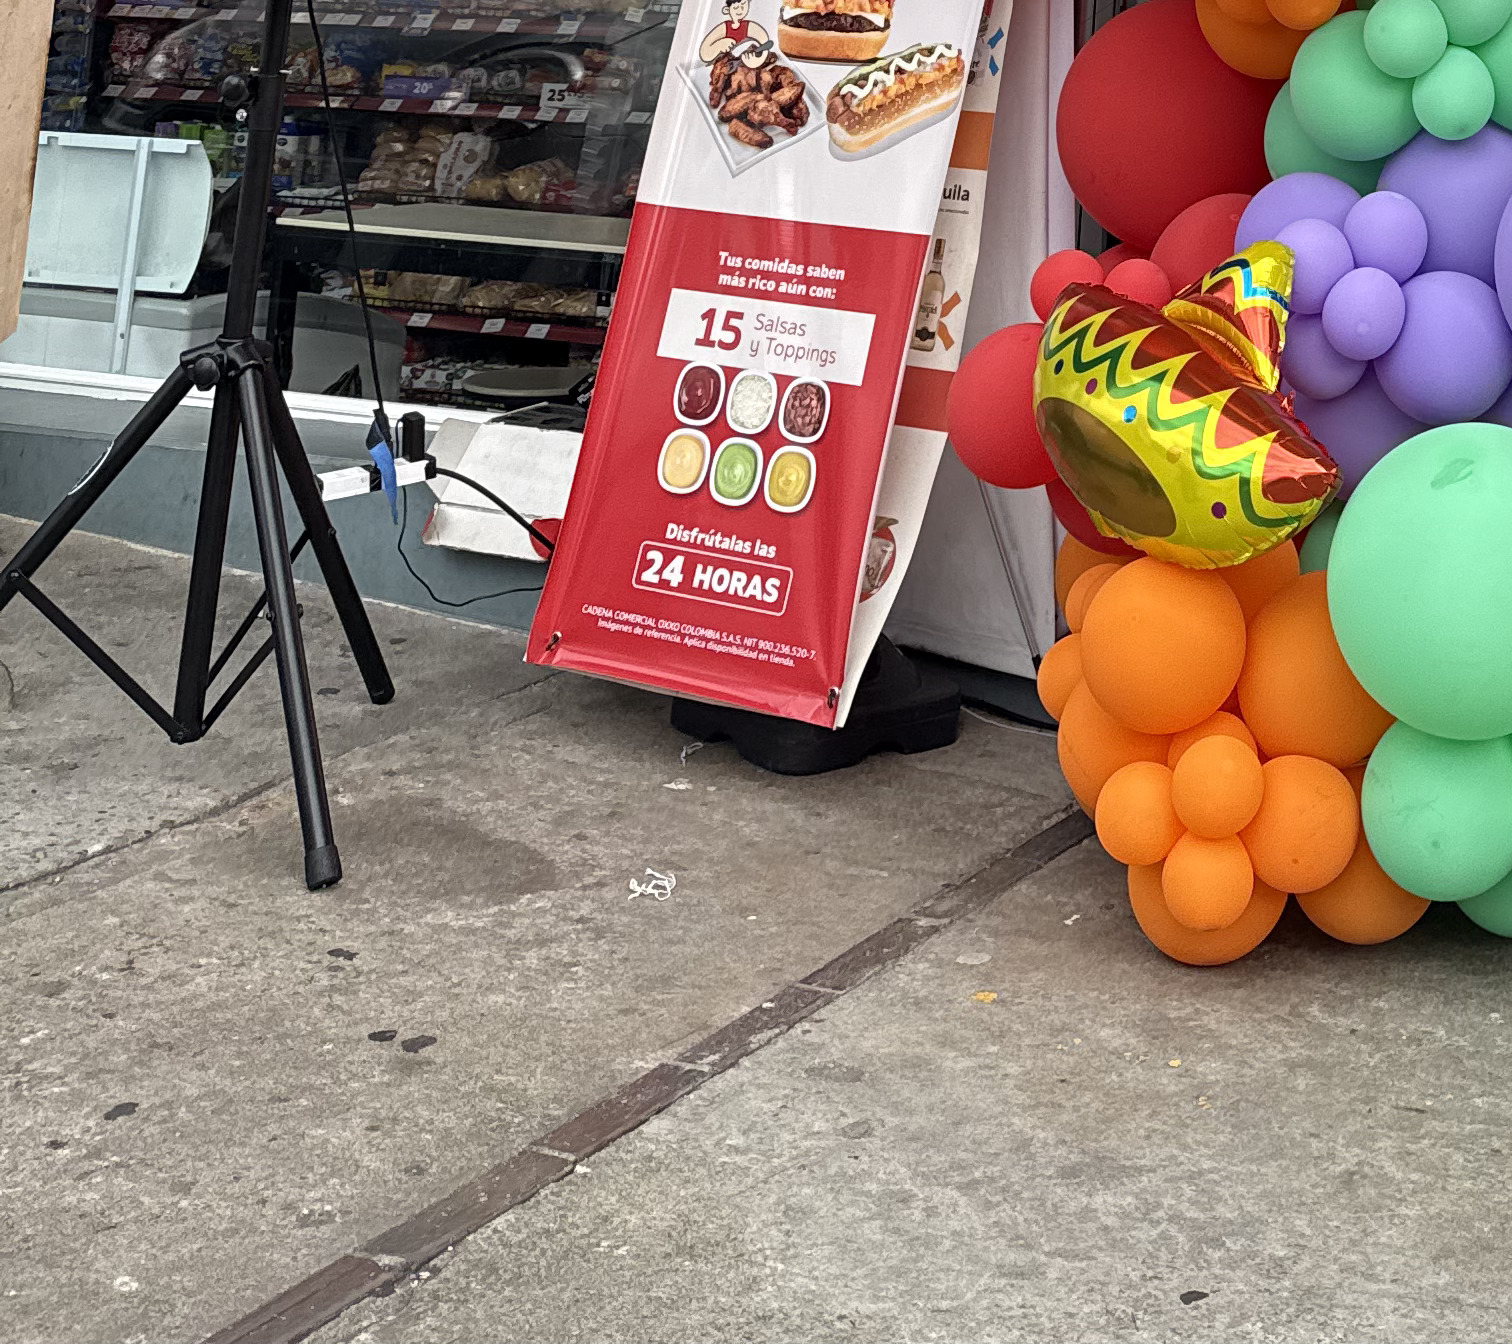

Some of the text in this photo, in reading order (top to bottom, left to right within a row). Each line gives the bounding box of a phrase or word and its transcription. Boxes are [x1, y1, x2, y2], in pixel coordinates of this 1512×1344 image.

[719, 251, 845, 280] Tus comidas saben
[718, 271, 836, 299] más rico aún con:
[693, 307, 807, 353] 15 Salsas
[748, 337, 836, 367] y Toppings
[665, 523, 777, 559] Disfrútalas las
[641, 551, 780, 603] 24 HORAS
[581, 603, 613, 620] CADENA
[613, 610, 657, 629] COMERCIAL
[680, 622, 721, 642] COLOMBIA
[720, 631, 743, 645] S.A.S.
[597, 618, 634, 635] Imágenes
[682, 635, 706, 650] Aplica
